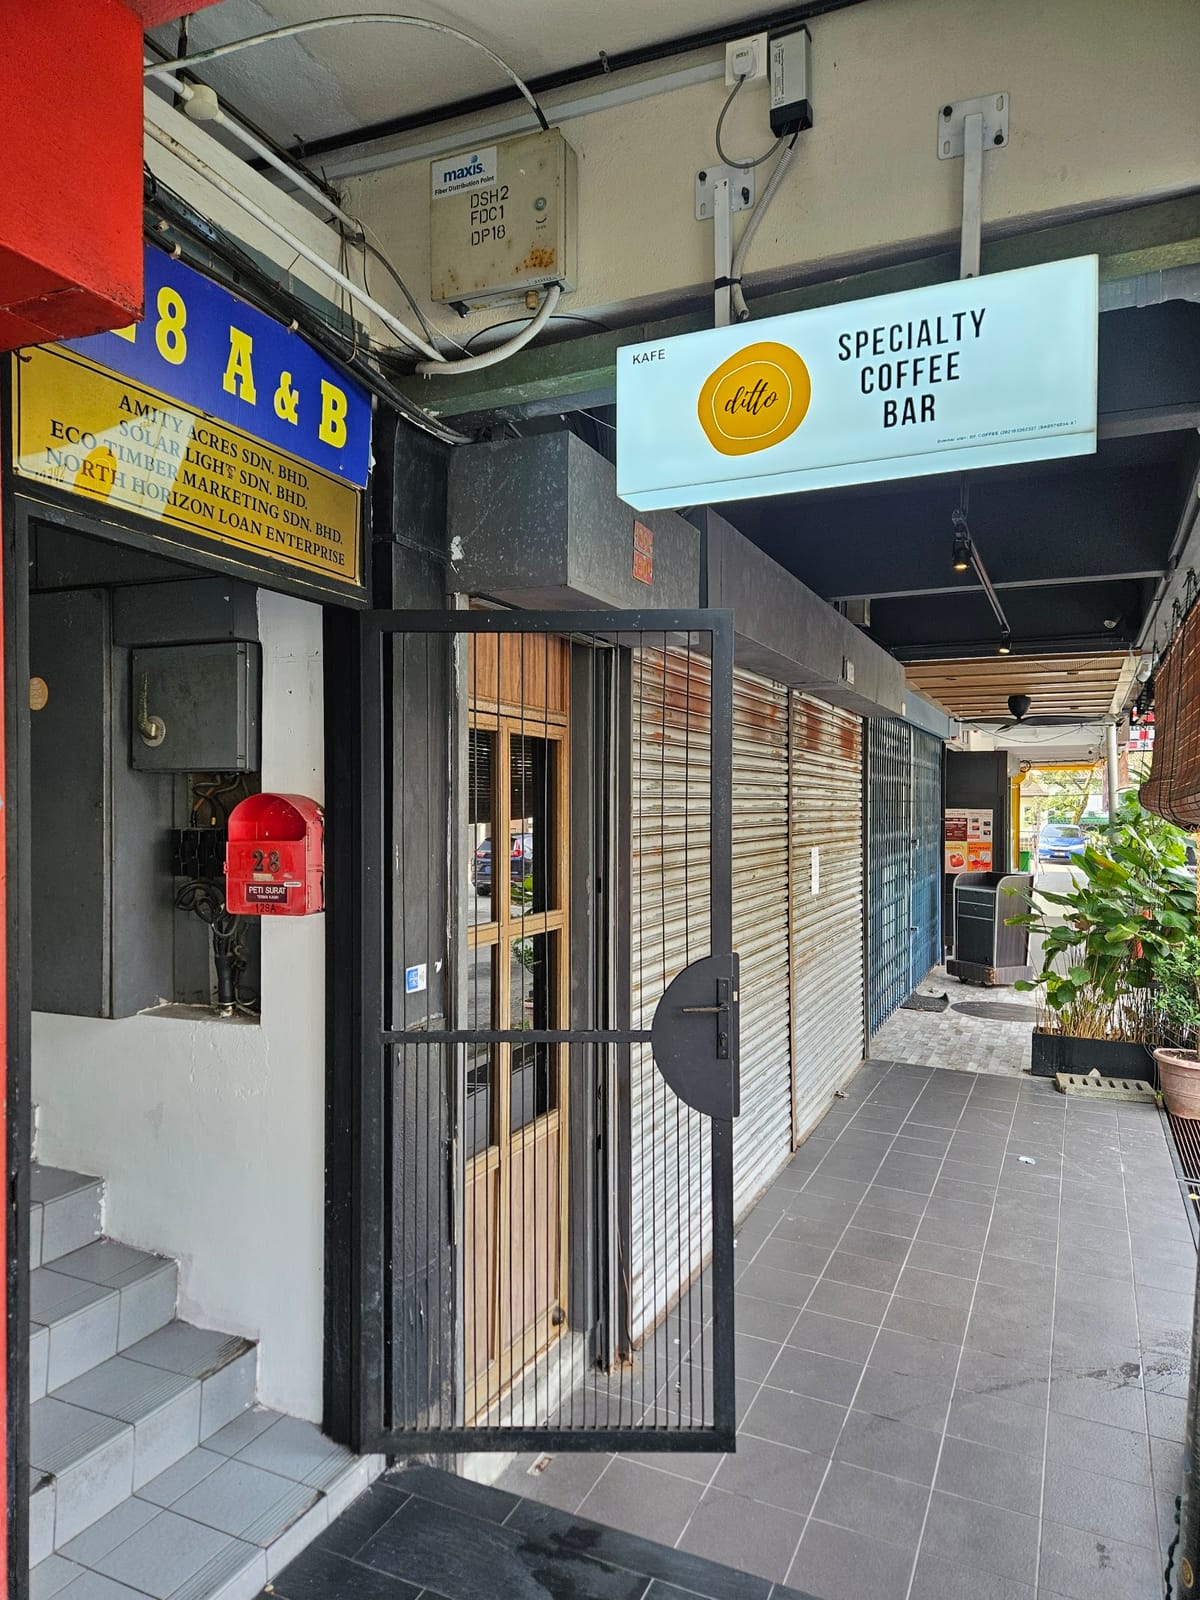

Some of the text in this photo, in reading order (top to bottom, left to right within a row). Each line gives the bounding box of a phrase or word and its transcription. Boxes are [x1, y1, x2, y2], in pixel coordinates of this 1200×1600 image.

[434, 175, 495, 196] Fiber Distribution Point
[443, 155, 483, 183] maxis
[470, 185, 509, 209] DSH2
[470, 204, 504, 226] FDC1
[471, 224, 506, 246] DP18
[838, 308, 986, 361] SPECIALTY
[632, 349, 666, 365] KAFE
[861, 351, 960, 394] COFFEE
[223, 325, 257, 406] A
[274, 371, 299, 426] &
[319, 379, 348, 449] B
[724, 379, 778, 415] ditto
[883, 394, 935, 428] BAR
[118, 394, 310, 490] AMITY ACRES SDN. BHD.
[119, 419, 181, 458] SOLAR
[240, 470, 272, 497] SDN.
[276, 485, 308, 510] BHD.
[50, 419, 97, 450] ECO
[104, 439, 178, 481] TIMBER
[182, 470, 279, 519] MARKETING
[283, 509, 312, 533] SDN.
[315, 522, 343, 545] BHD.
[45, 447, 126, 489] NORTH
[132, 476, 215, 519] HORIZON
[218, 508, 262, 536] LOAN
[266, 526, 345, 566] ENTERPRISE
[252, 849, 280, 872] 28
[248, 886, 286, 895] PETI SURAT
